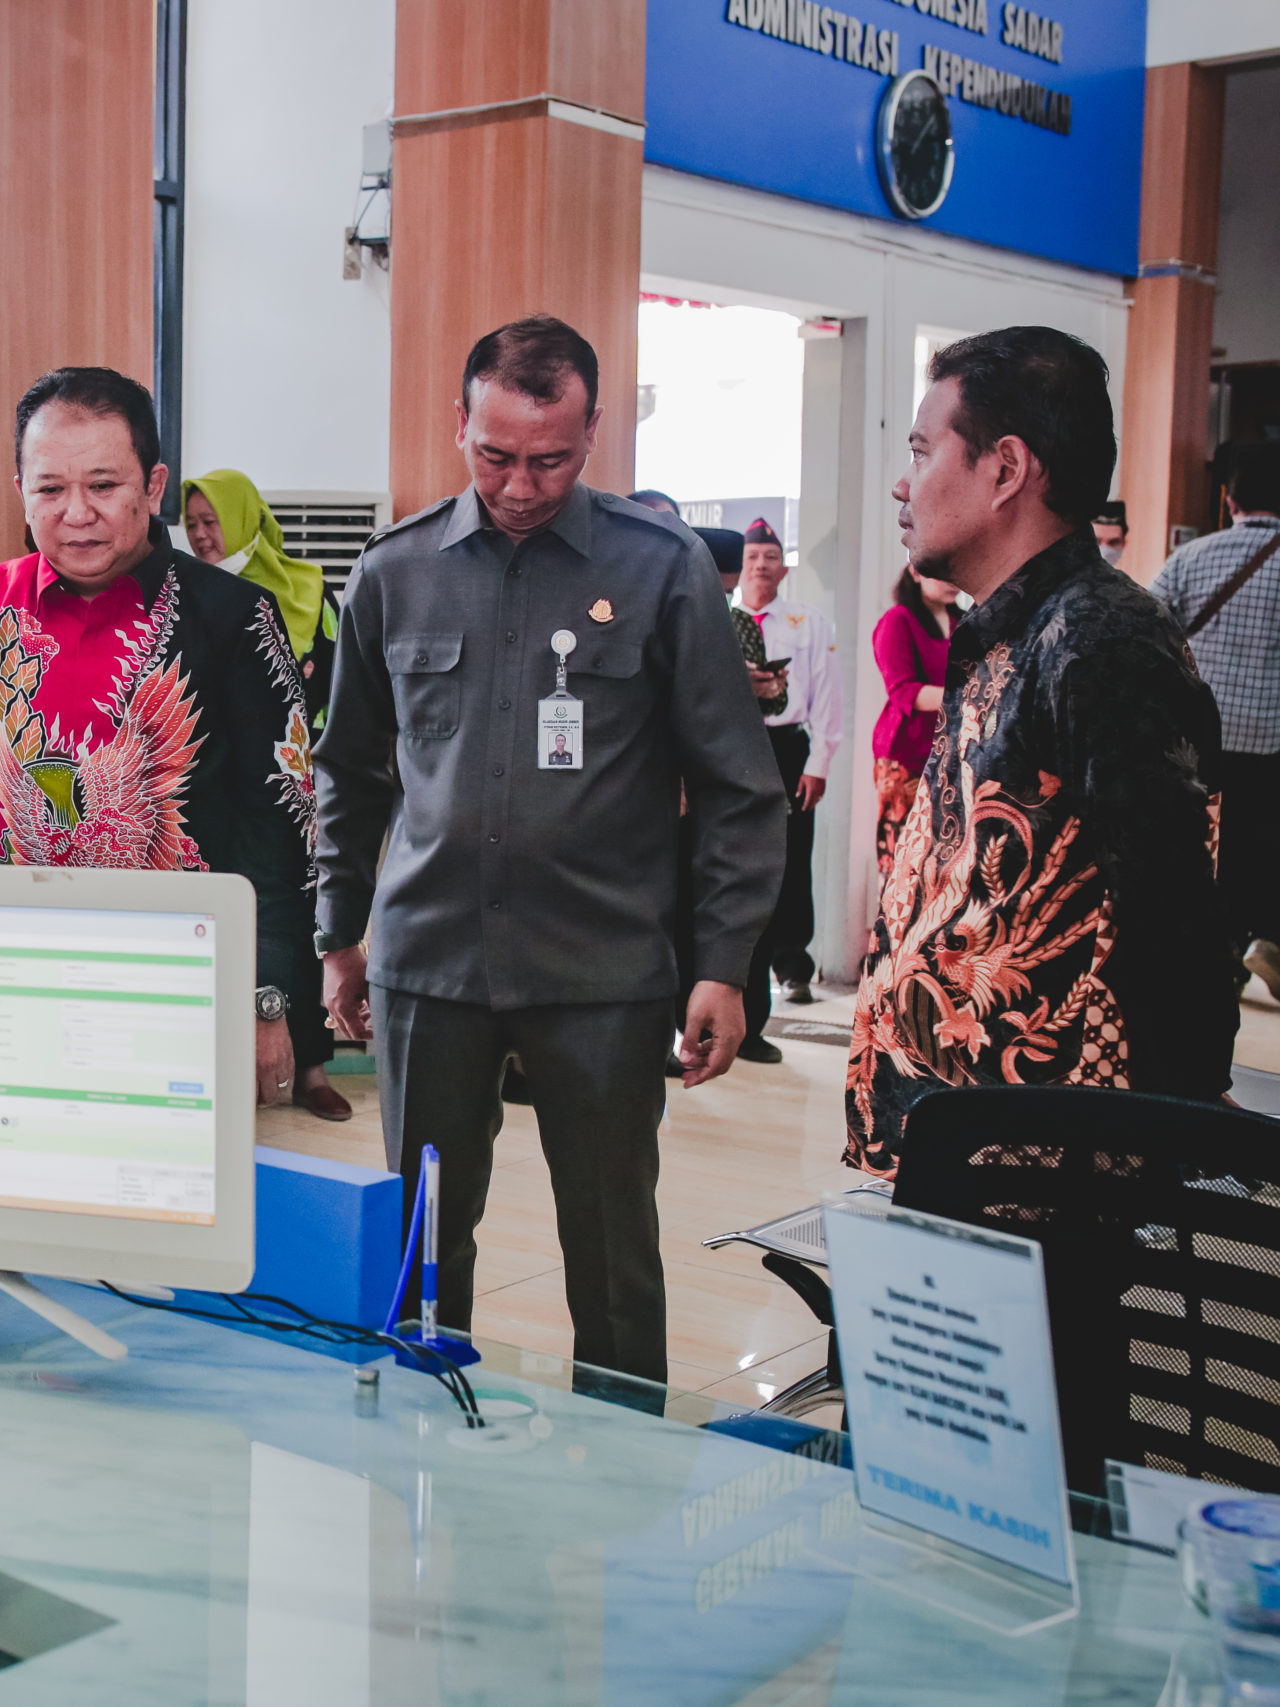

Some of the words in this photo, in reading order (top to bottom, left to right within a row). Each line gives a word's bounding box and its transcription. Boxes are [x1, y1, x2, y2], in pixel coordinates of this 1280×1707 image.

[725, 0, 900, 77] ADMINISTRASI
[1001, 1, 1063, 64] SADAR
[865, 1463, 959, 1517] TERIMA
[968, 1500, 1051, 1549] KASIH
